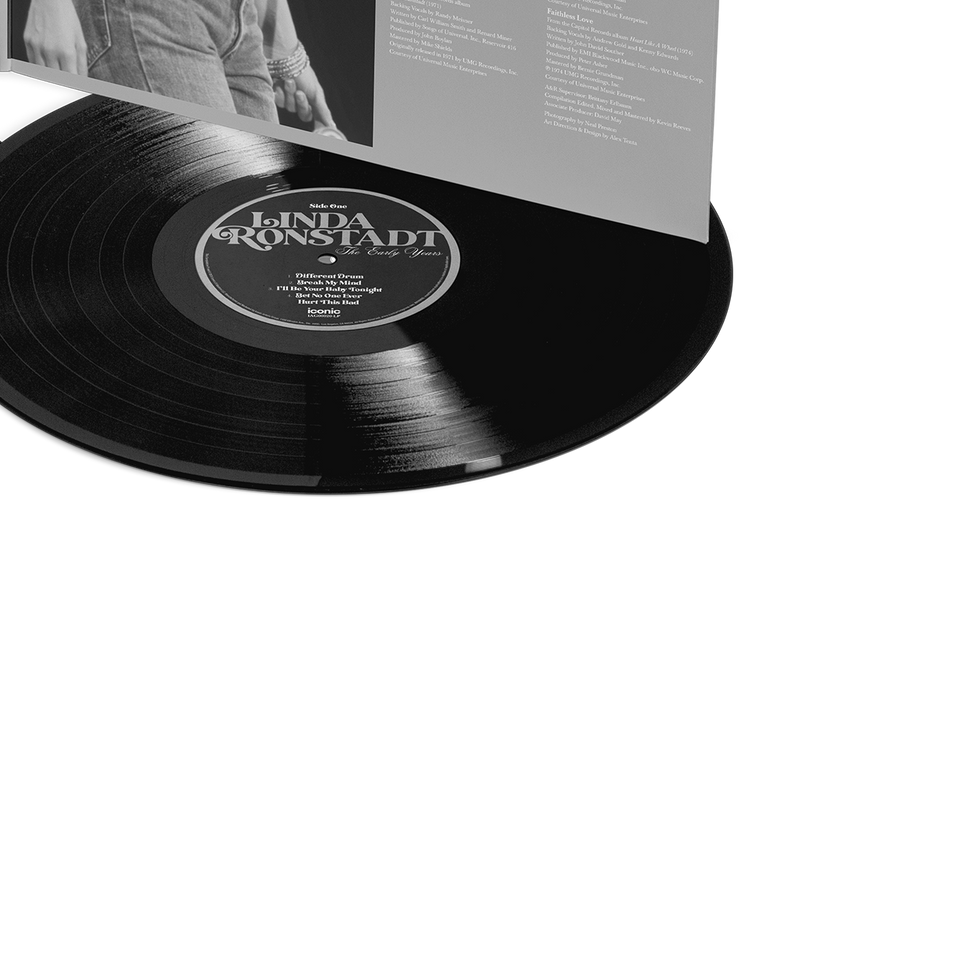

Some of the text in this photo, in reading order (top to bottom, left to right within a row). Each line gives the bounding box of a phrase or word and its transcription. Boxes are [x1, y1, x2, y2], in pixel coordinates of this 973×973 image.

[547, 7, 593, 24] Faithless Love
[544, 110, 576, 124] Photography
[594, 112, 609, 120] David
[610, 116, 621, 124] May
[252, 211, 375, 228] LINDA
[211, 225, 442, 251] RONSTADT
[335, 246, 442, 258] The Early Years
